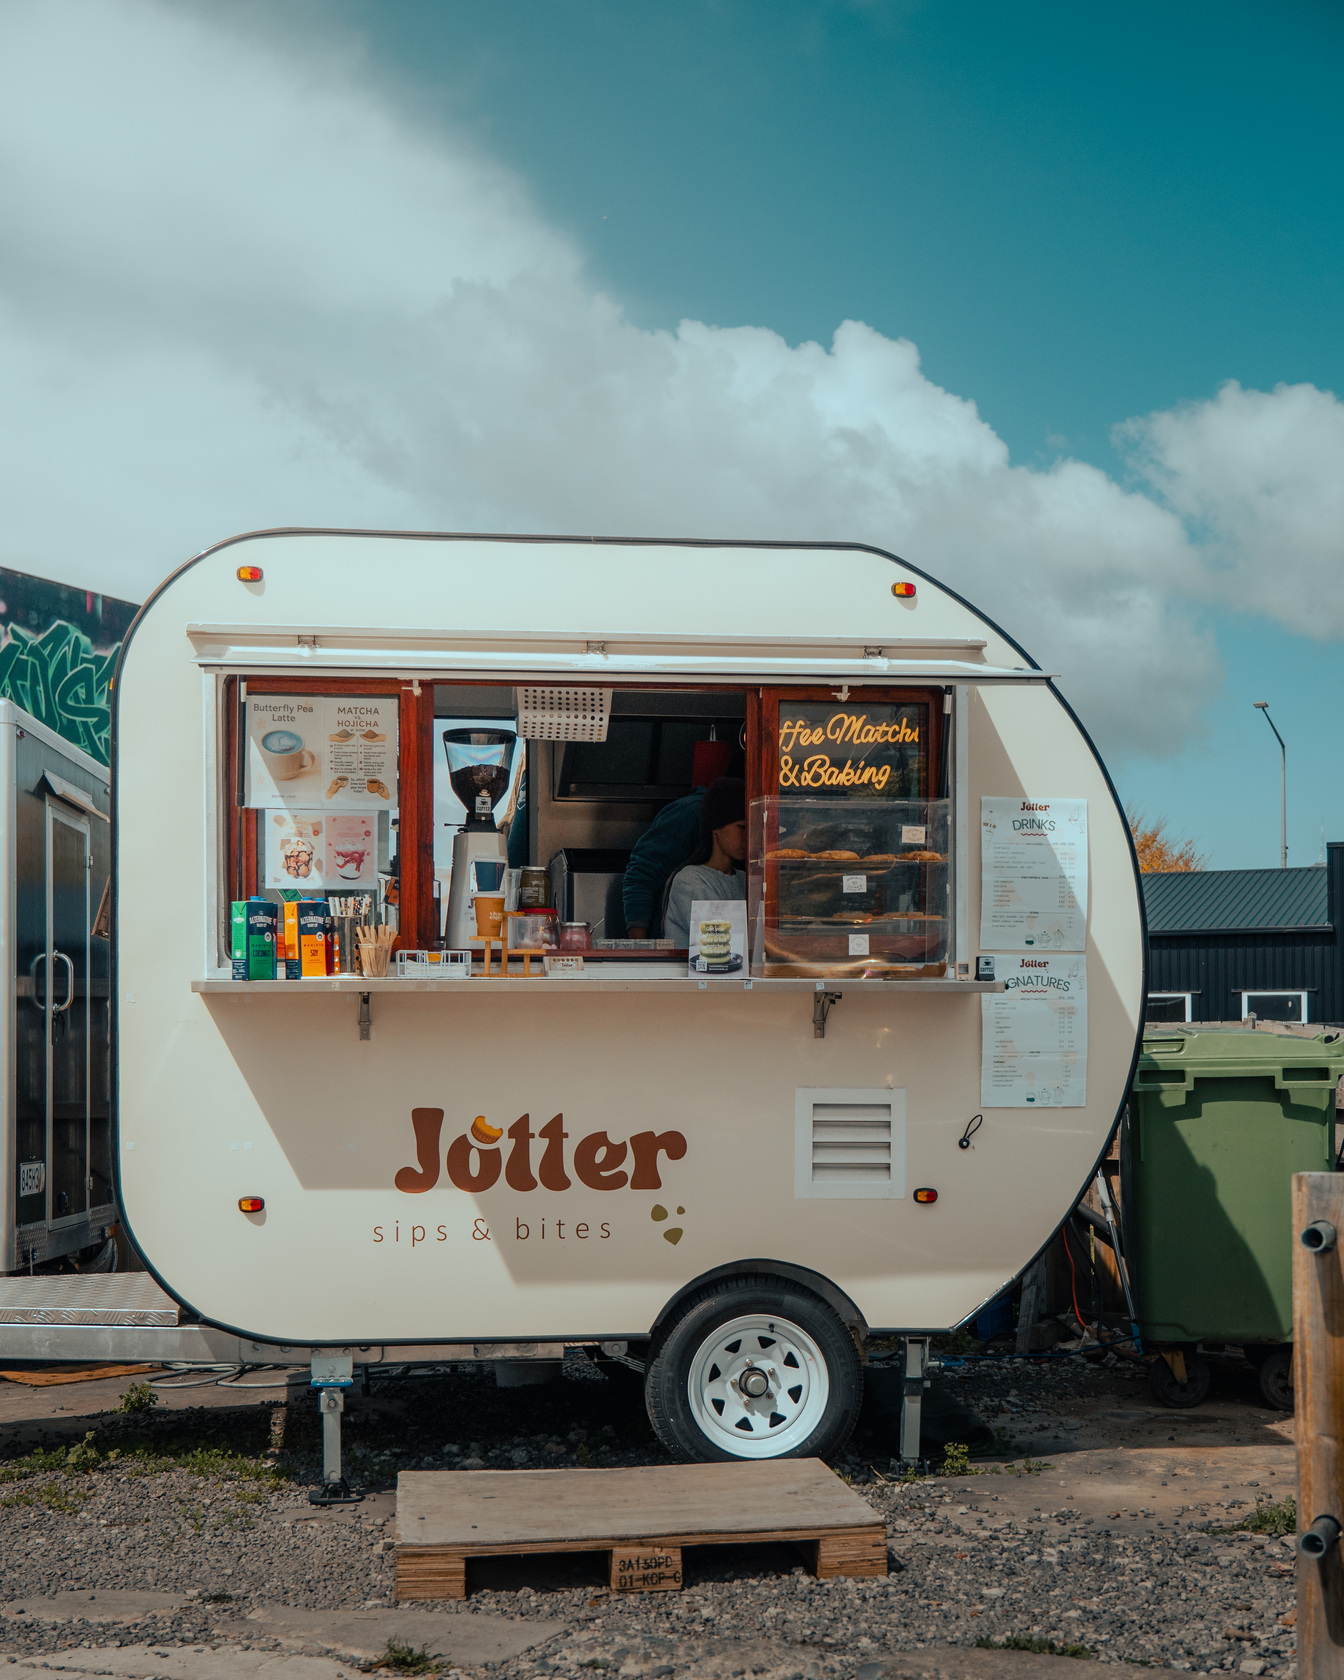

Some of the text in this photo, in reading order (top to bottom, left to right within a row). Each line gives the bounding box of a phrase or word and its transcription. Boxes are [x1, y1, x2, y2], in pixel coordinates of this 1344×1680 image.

[253, 703, 314, 714] Butterfly Pea
[337, 707, 380, 715] MATCHA
[272, 714, 296, 722] Latte
[337, 720, 379, 728] HOJICHA
[779, 719, 825, 752] ffee
[801, 754, 891, 790] Baking
[1020, 801, 1050, 811] Jotter
[1012, 818, 1056, 831] DRINKS
[252, 949, 271, 957] COCONUT
[310, 949, 318, 957] SOY
[1019, 958, 1049, 968] Jotter
[1004, 975, 1071, 992] GNATURES
[394, 1107, 688, 1194] Jotter
[373, 1217, 611, 1247] sips & bites
